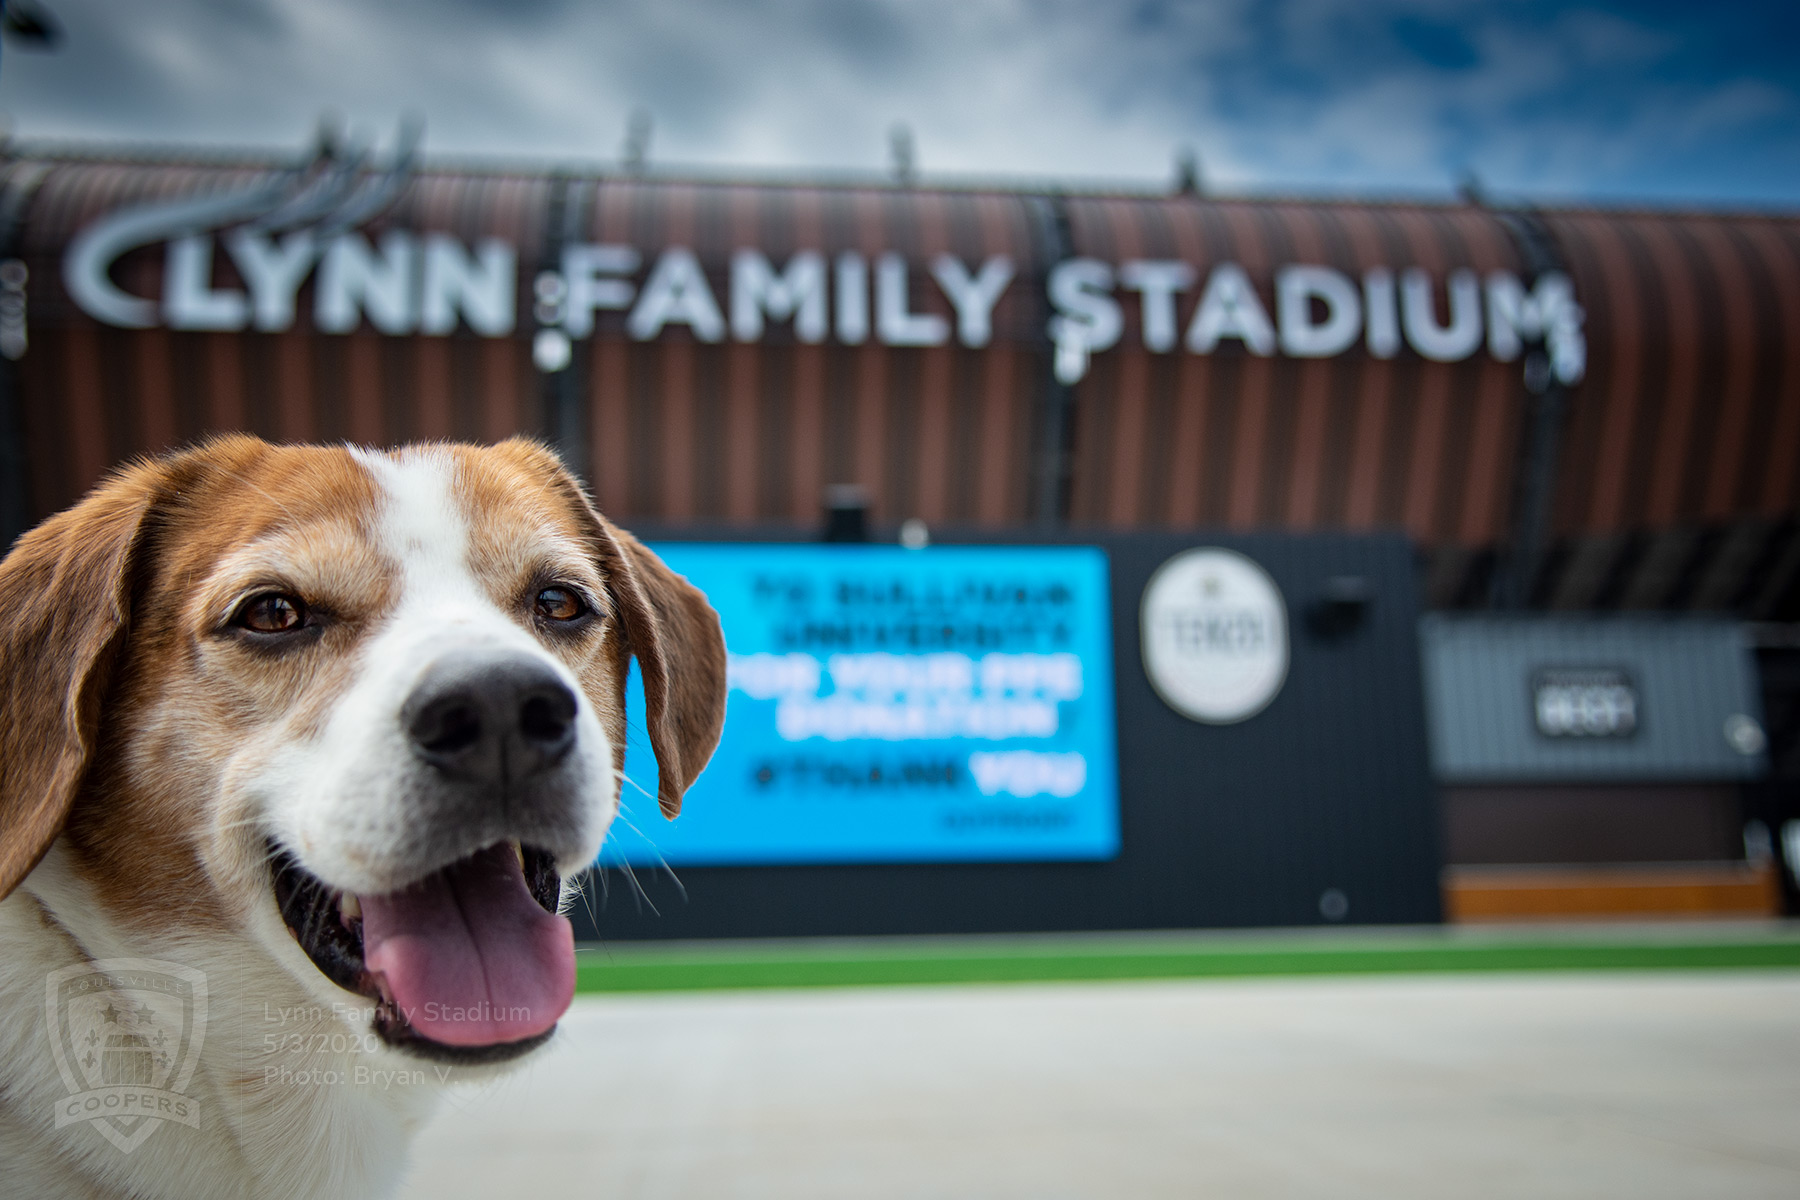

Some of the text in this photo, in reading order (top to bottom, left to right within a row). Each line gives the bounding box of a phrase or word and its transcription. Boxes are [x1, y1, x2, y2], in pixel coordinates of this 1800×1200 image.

[559, 243, 1016, 348] FAMILY
[1046, 256, 1582, 364] STADIUM
[830, 653, 972, 698] YOUR
